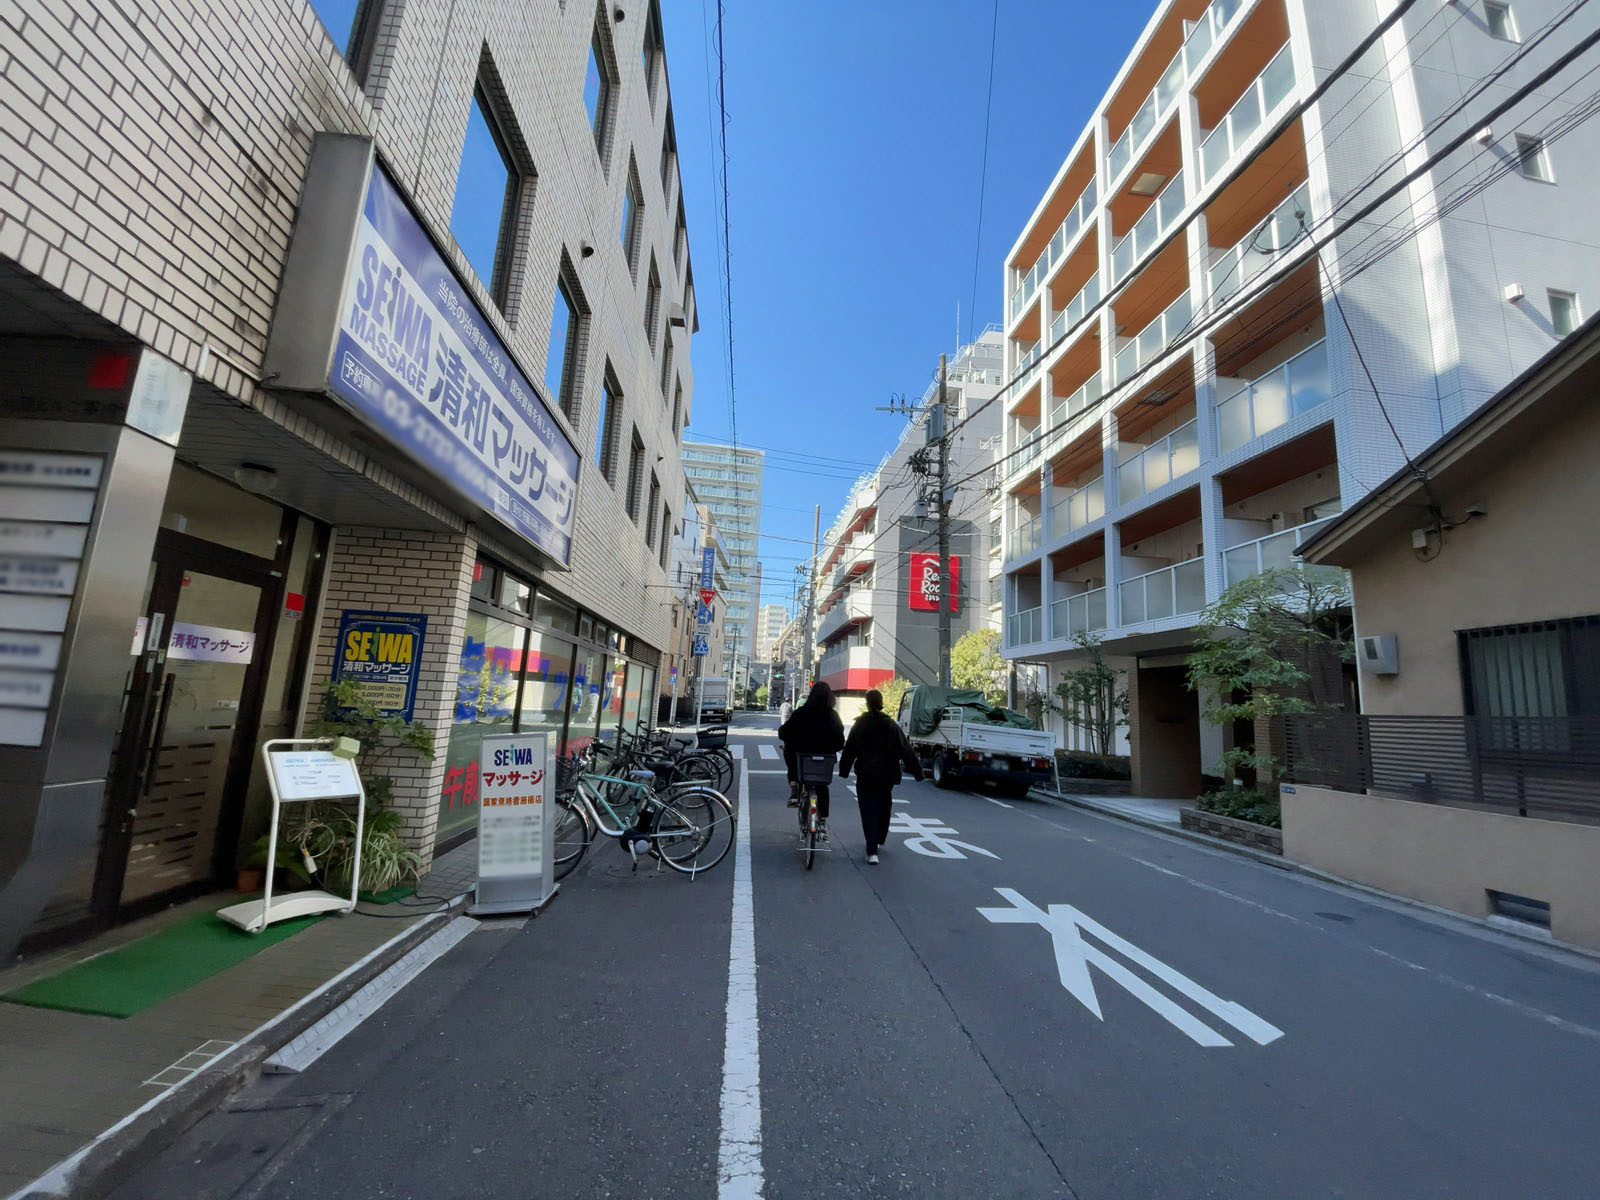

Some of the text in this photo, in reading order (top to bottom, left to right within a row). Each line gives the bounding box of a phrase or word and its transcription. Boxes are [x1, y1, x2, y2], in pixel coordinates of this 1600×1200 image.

[349, 307, 429, 397] MASSAGE
[427, 331, 574, 526] 清和マッサージ
[923, 567, 940, 581] Re
[921, 580, 940, 594] Roo
[171, 633, 250, 653] 清和マッサージ
[343, 661, 410, 674] 清和マッサージ
[482, 769, 543, 787] マッサージ
